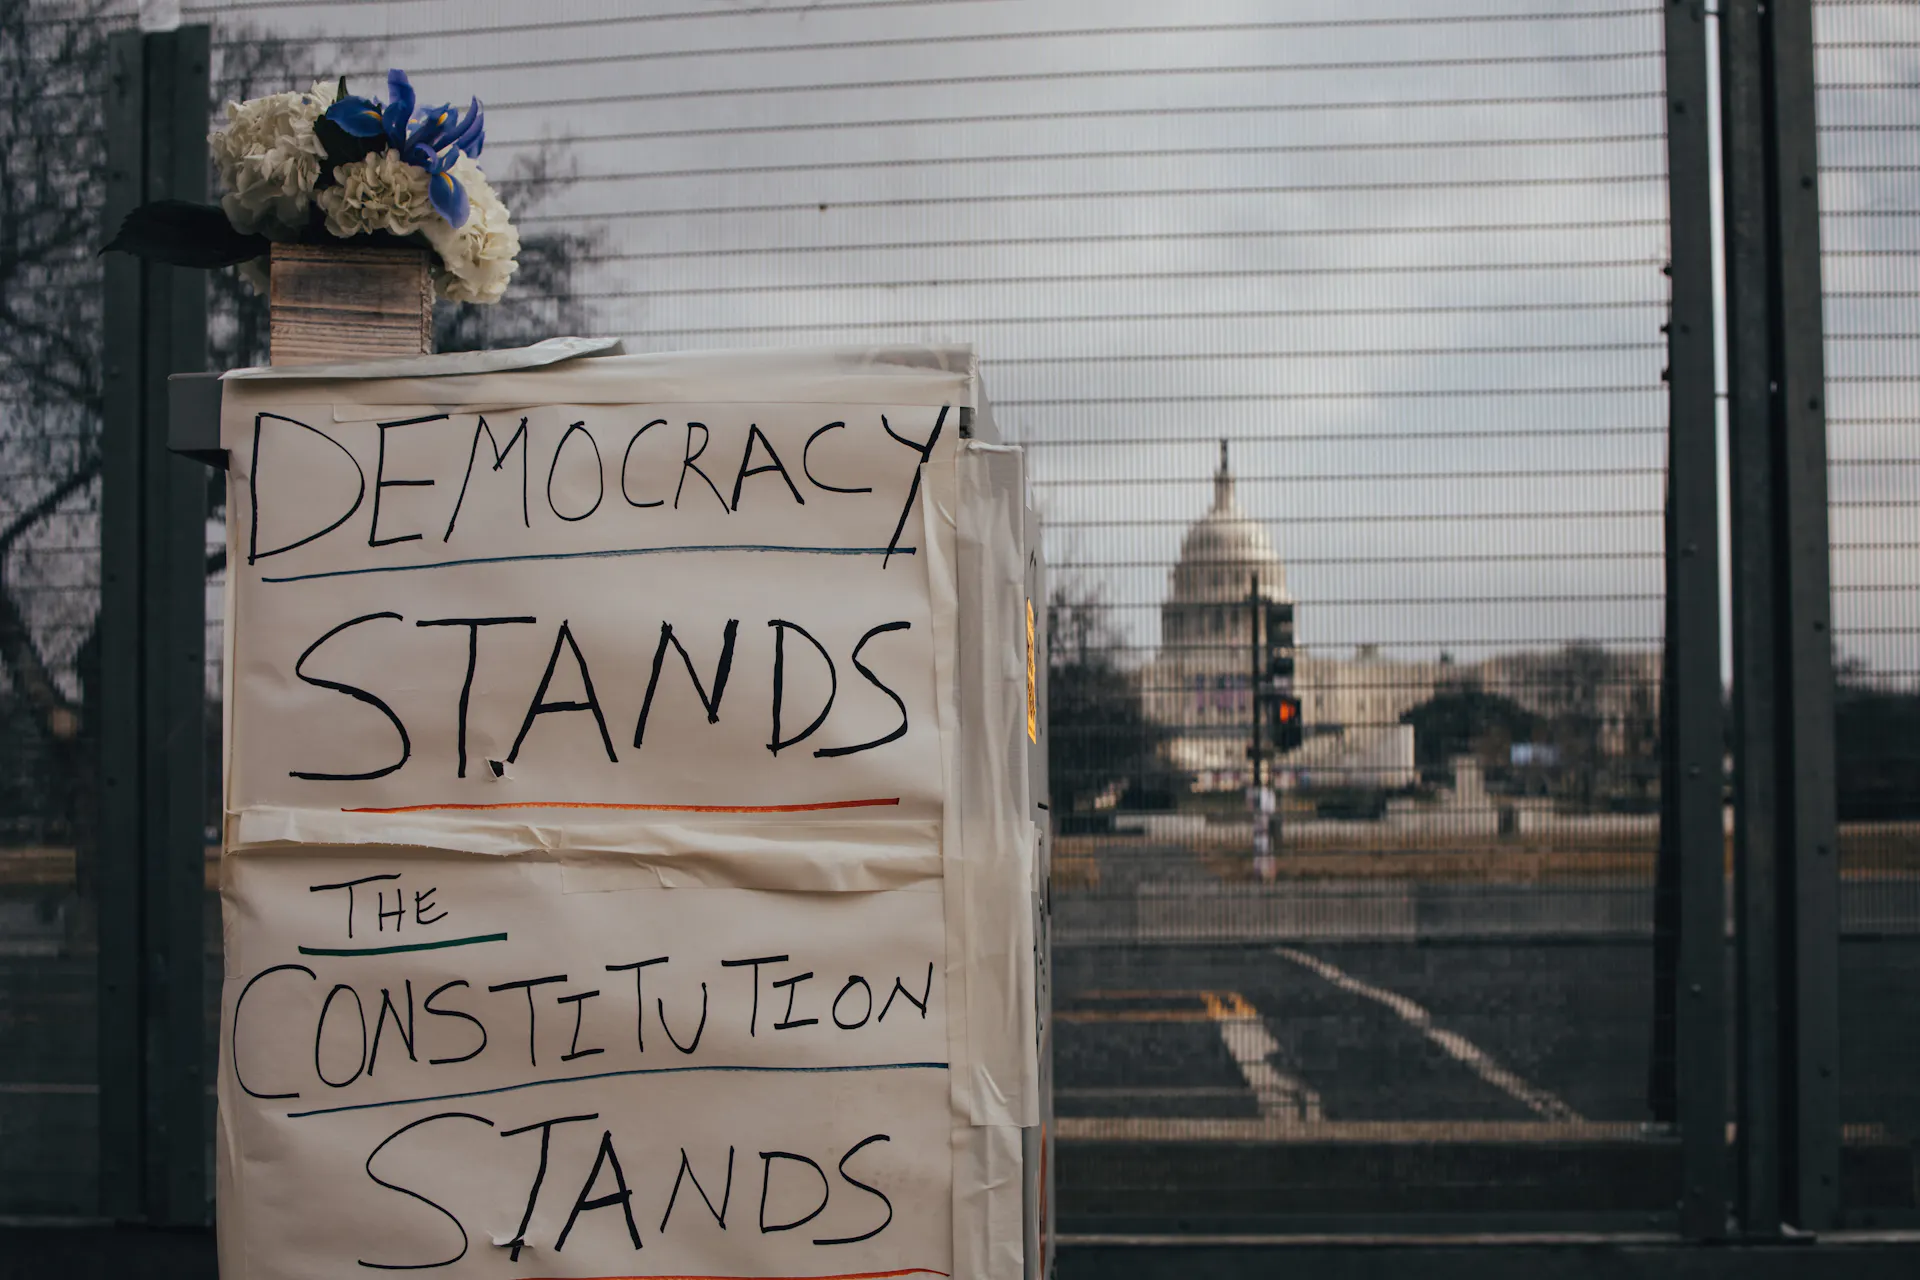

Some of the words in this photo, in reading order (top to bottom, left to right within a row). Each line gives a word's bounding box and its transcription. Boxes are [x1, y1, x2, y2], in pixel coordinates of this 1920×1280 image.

[249, 405, 949, 569] DEMOCRACY
[289, 611, 912, 781] STANDS
[310, 873, 449, 938] THE
[233, 955, 934, 1099] CONSTITUTION
[358, 1112, 894, 1270] STANDS
